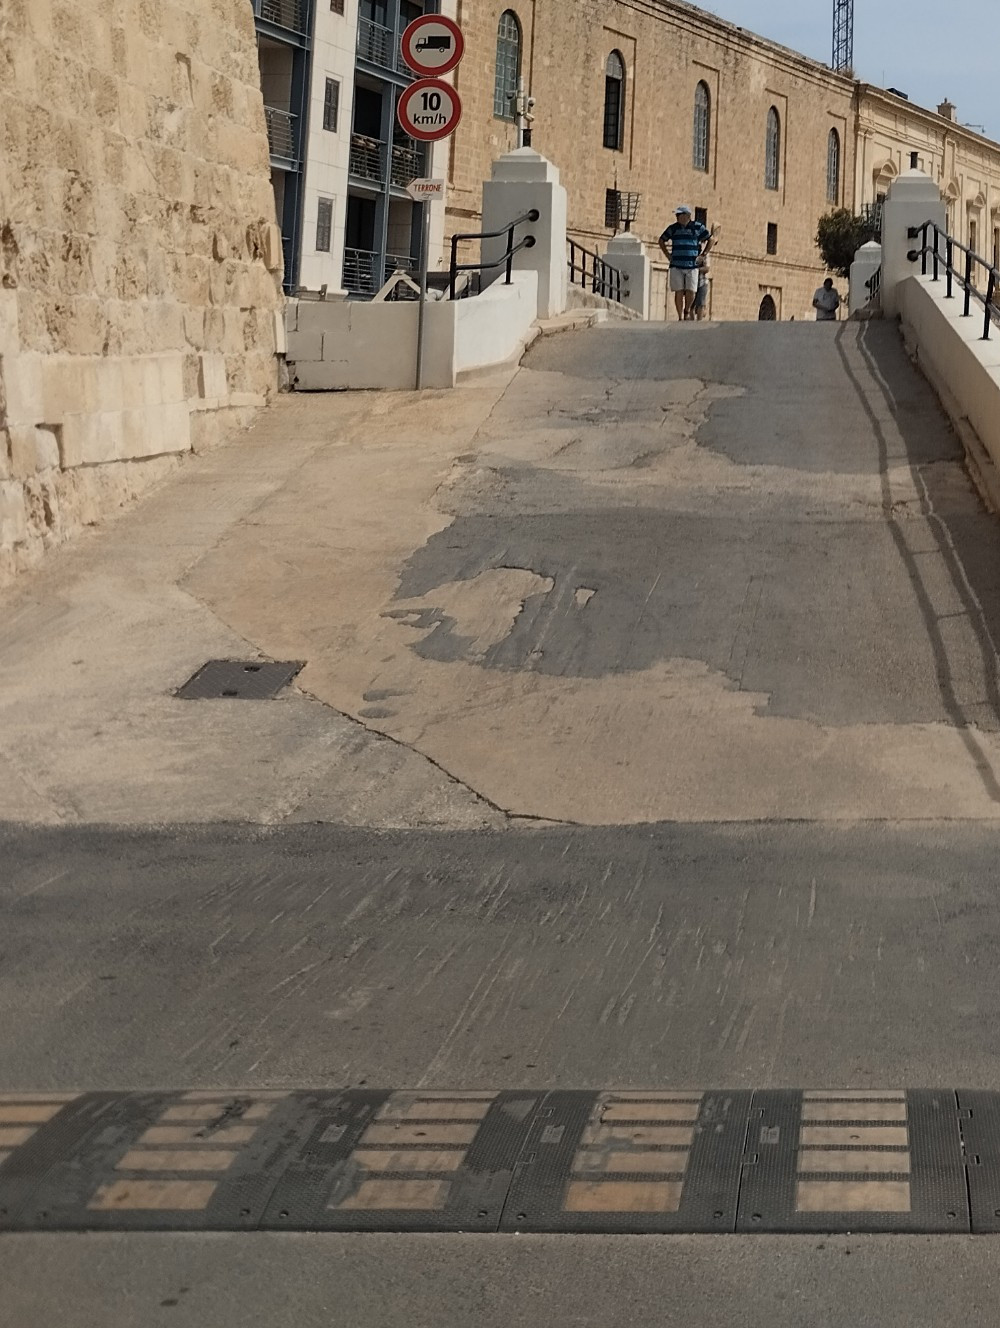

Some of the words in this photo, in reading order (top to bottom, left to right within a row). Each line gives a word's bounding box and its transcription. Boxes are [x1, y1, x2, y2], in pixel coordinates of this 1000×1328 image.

[421, 92, 441, 111] 10
[413, 113, 447, 125] km/h
[413, 183, 442, 193] TERRONE
